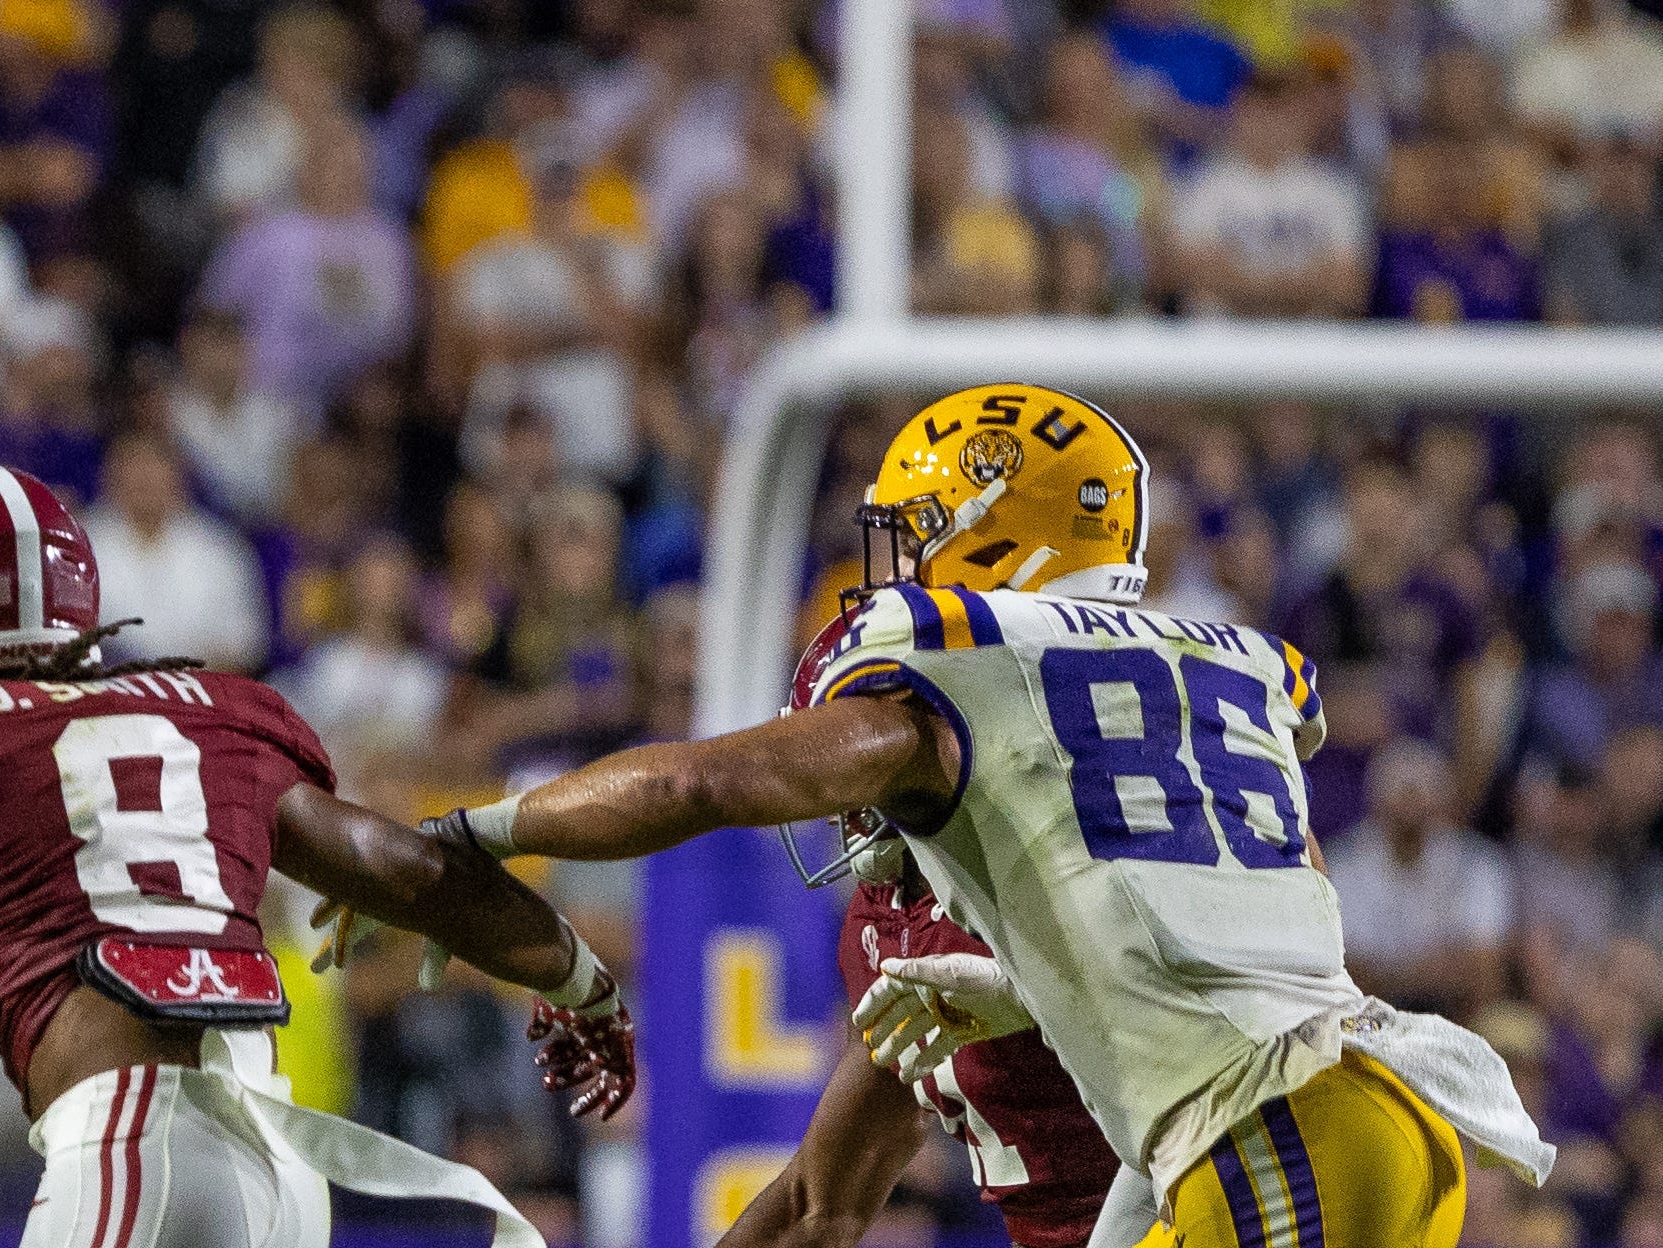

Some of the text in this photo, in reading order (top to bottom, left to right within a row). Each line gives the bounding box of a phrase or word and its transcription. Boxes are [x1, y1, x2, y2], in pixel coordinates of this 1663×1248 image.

[924, 395, 1087, 451] LSU
[1049, 602, 1250, 656] TAYLOR
[52, 713, 235, 935] 8
[1040, 647, 1308, 870] 86
